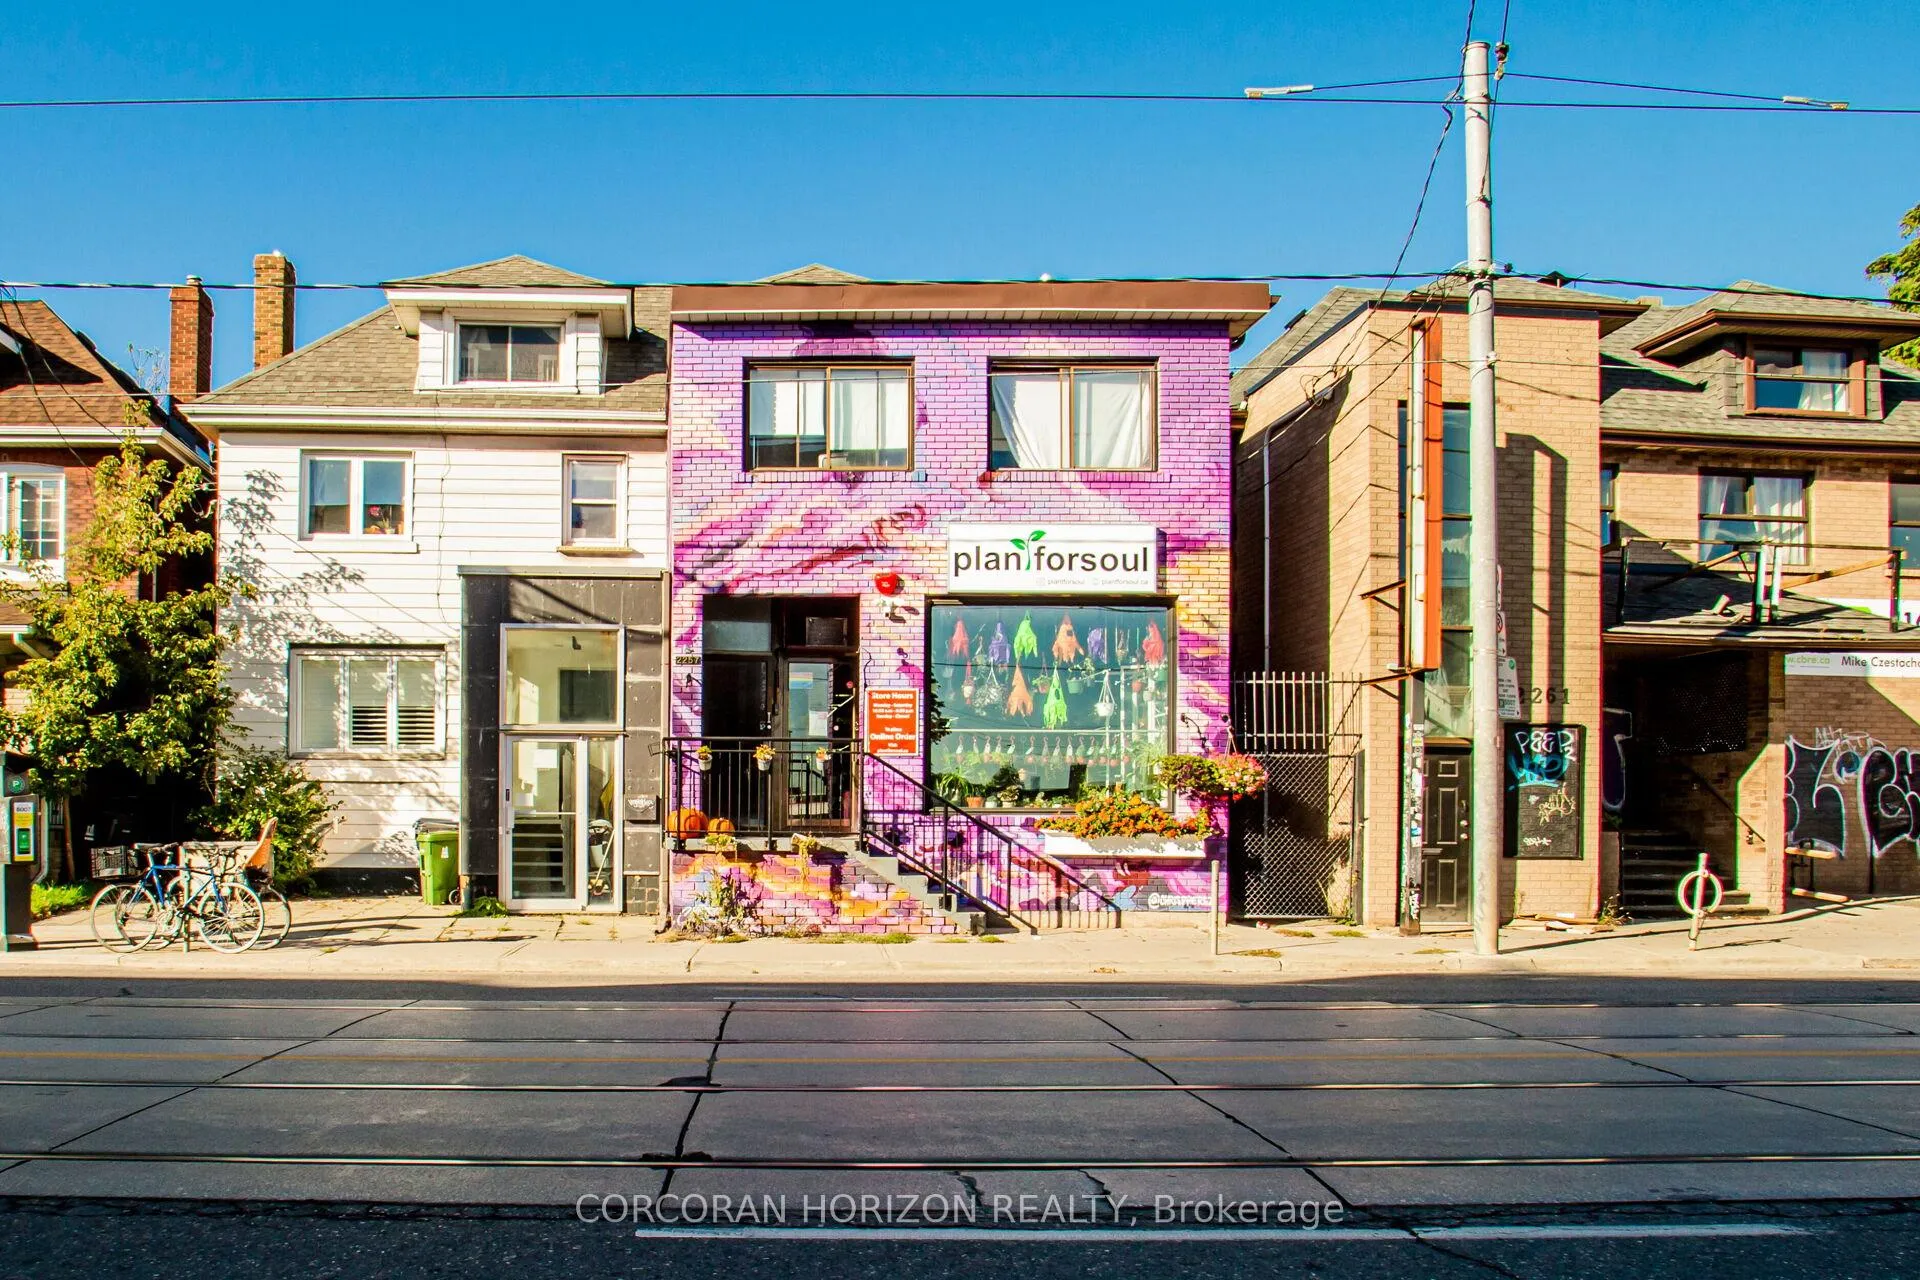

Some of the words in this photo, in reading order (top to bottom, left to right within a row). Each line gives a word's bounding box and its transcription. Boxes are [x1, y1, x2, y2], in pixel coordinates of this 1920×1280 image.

[676, 656, 701, 665] 2257
[1841, 655, 1867, 667] Mike
[871, 692, 891, 700] Store
[892, 692, 914, 700] Hours
[870, 733, 894, 741] Online
[895, 733, 916, 741] Order
